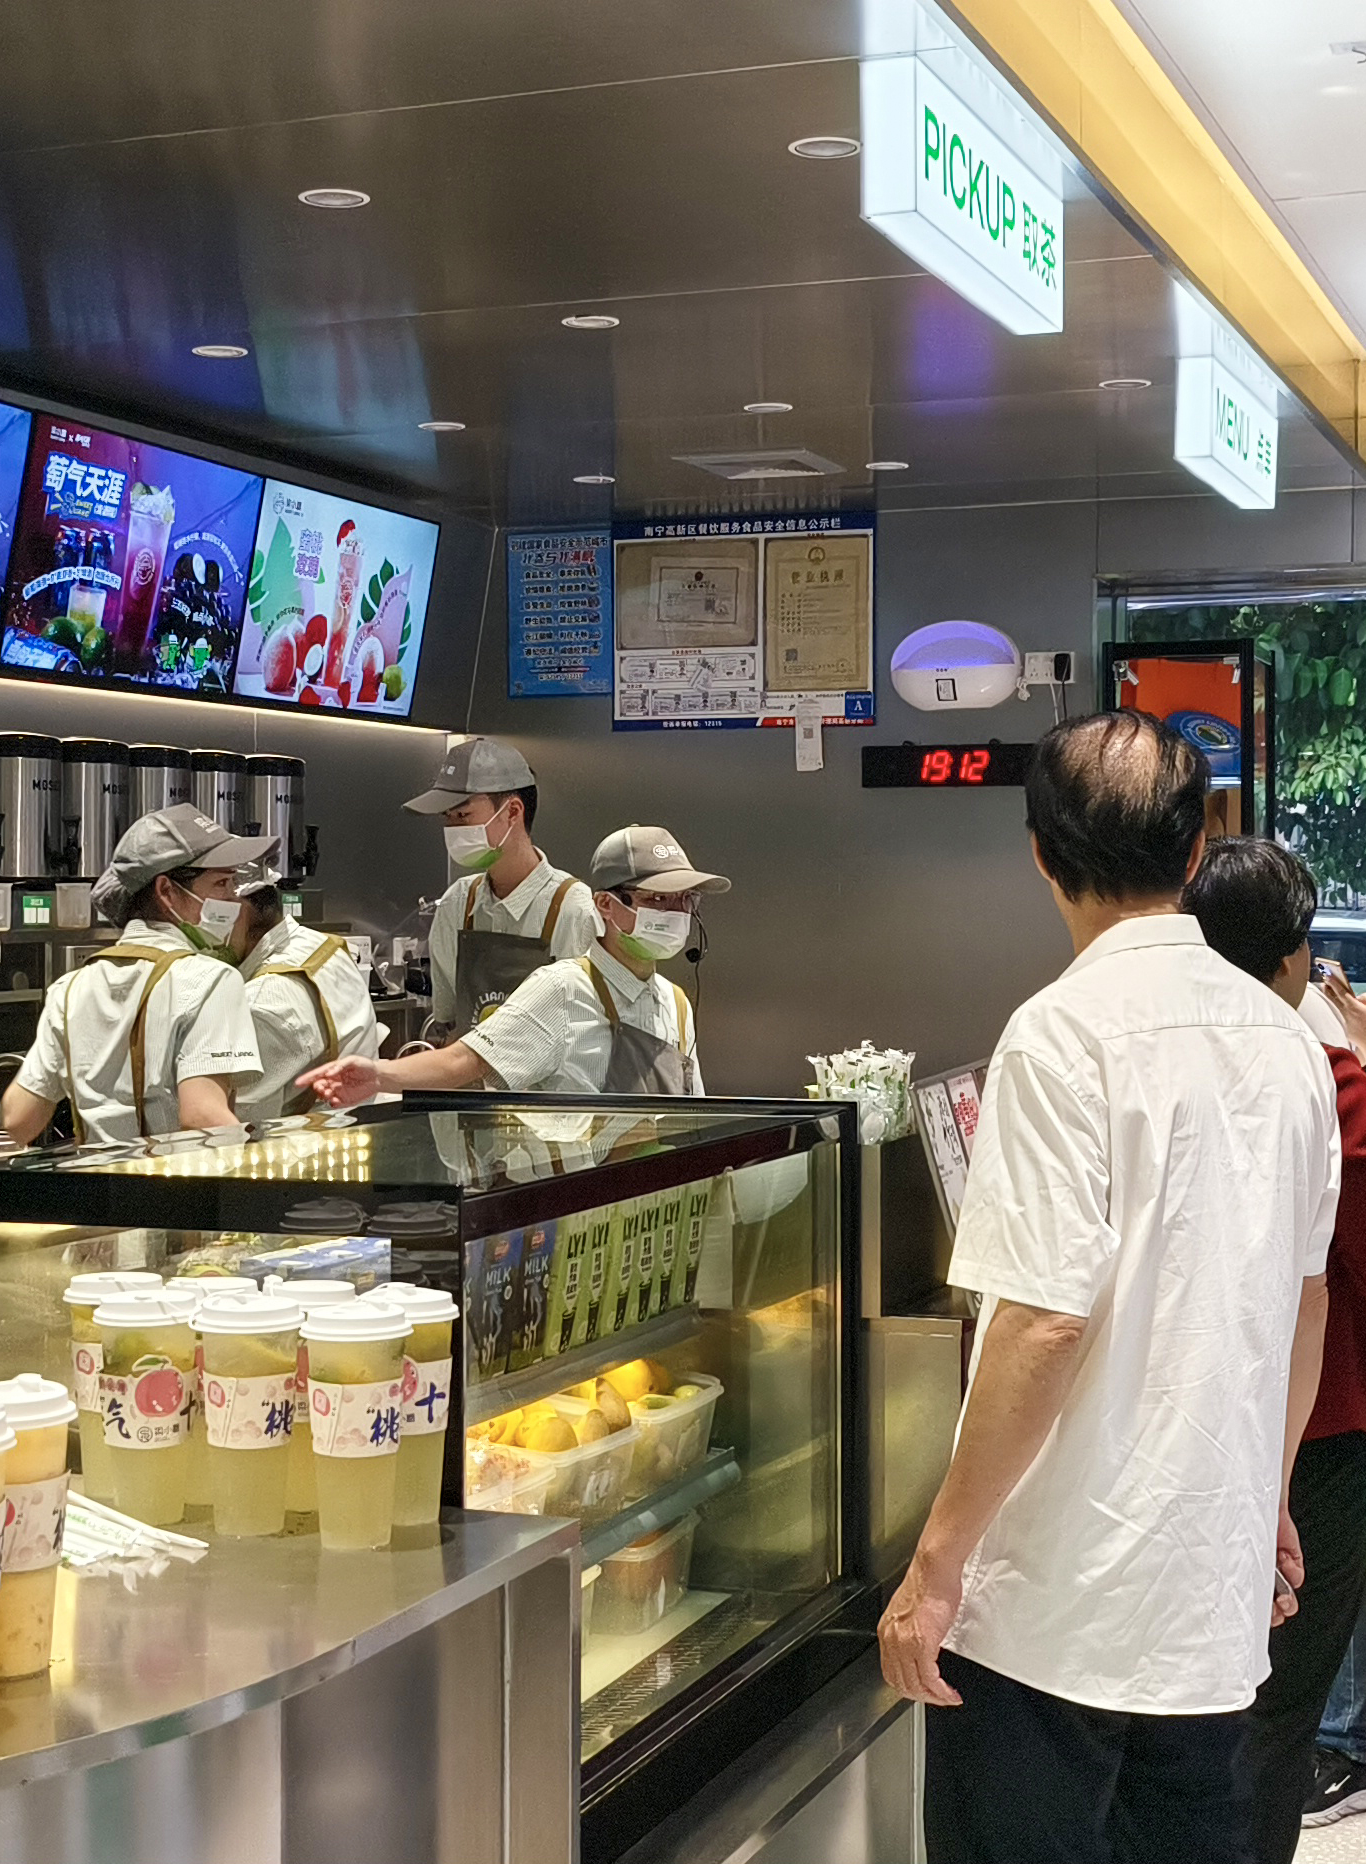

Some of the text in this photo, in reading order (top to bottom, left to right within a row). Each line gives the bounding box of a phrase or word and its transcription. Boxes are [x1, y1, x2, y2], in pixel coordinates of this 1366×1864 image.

[924, 104, 1057, 290] PICKUP 取茶
[1215, 387, 1250, 460] MENU
[643, 517, 842, 537] 南宁高新区餐饮服务食品安全信息公示栏
[479, 991, 509, 1004] LIAN
[524, 1254, 549, 1277] MILK
[486, 1267, 512, 1287] MILK
